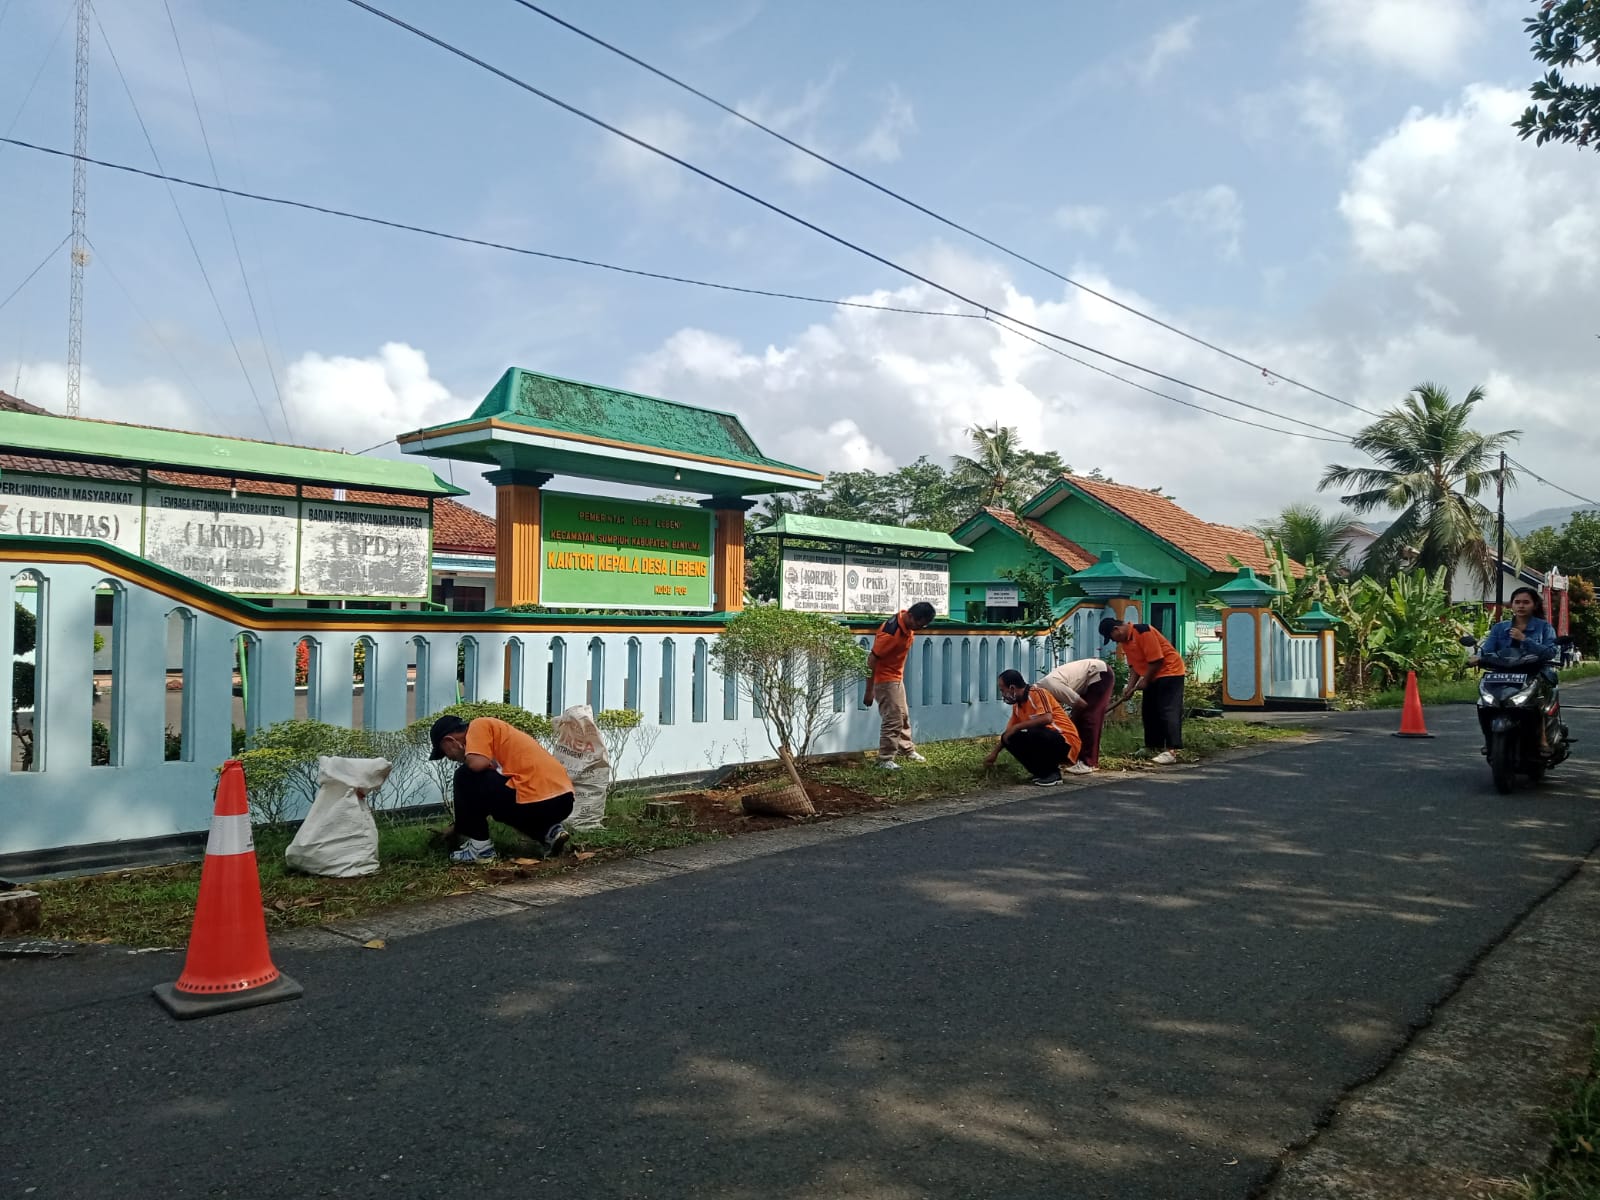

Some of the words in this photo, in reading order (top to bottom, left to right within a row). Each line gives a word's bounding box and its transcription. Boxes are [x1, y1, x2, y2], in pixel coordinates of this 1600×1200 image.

[72, 488, 134, 505] MASYARAKAT
[160, 495, 191, 509] LEMBAGA
[229, 501, 270, 516] MASYARAKAT
[270, 505, 285, 517] DESA
[308, 508, 333, 522] BADAN
[406, 516, 423, 529] DESA
[550, 529, 595, 543] KECAMATAN
[597, 535, 629, 545] SUMPIUH
[631, 537, 669, 549] KABUPATEN
[547, 551, 594, 571] KANTOR
[597, 554, 639, 574] KEPALA
[641, 557, 667, 576] DESA
[669, 559, 707, 578] LEBENG
[654, 585, 671, 596] KODE
